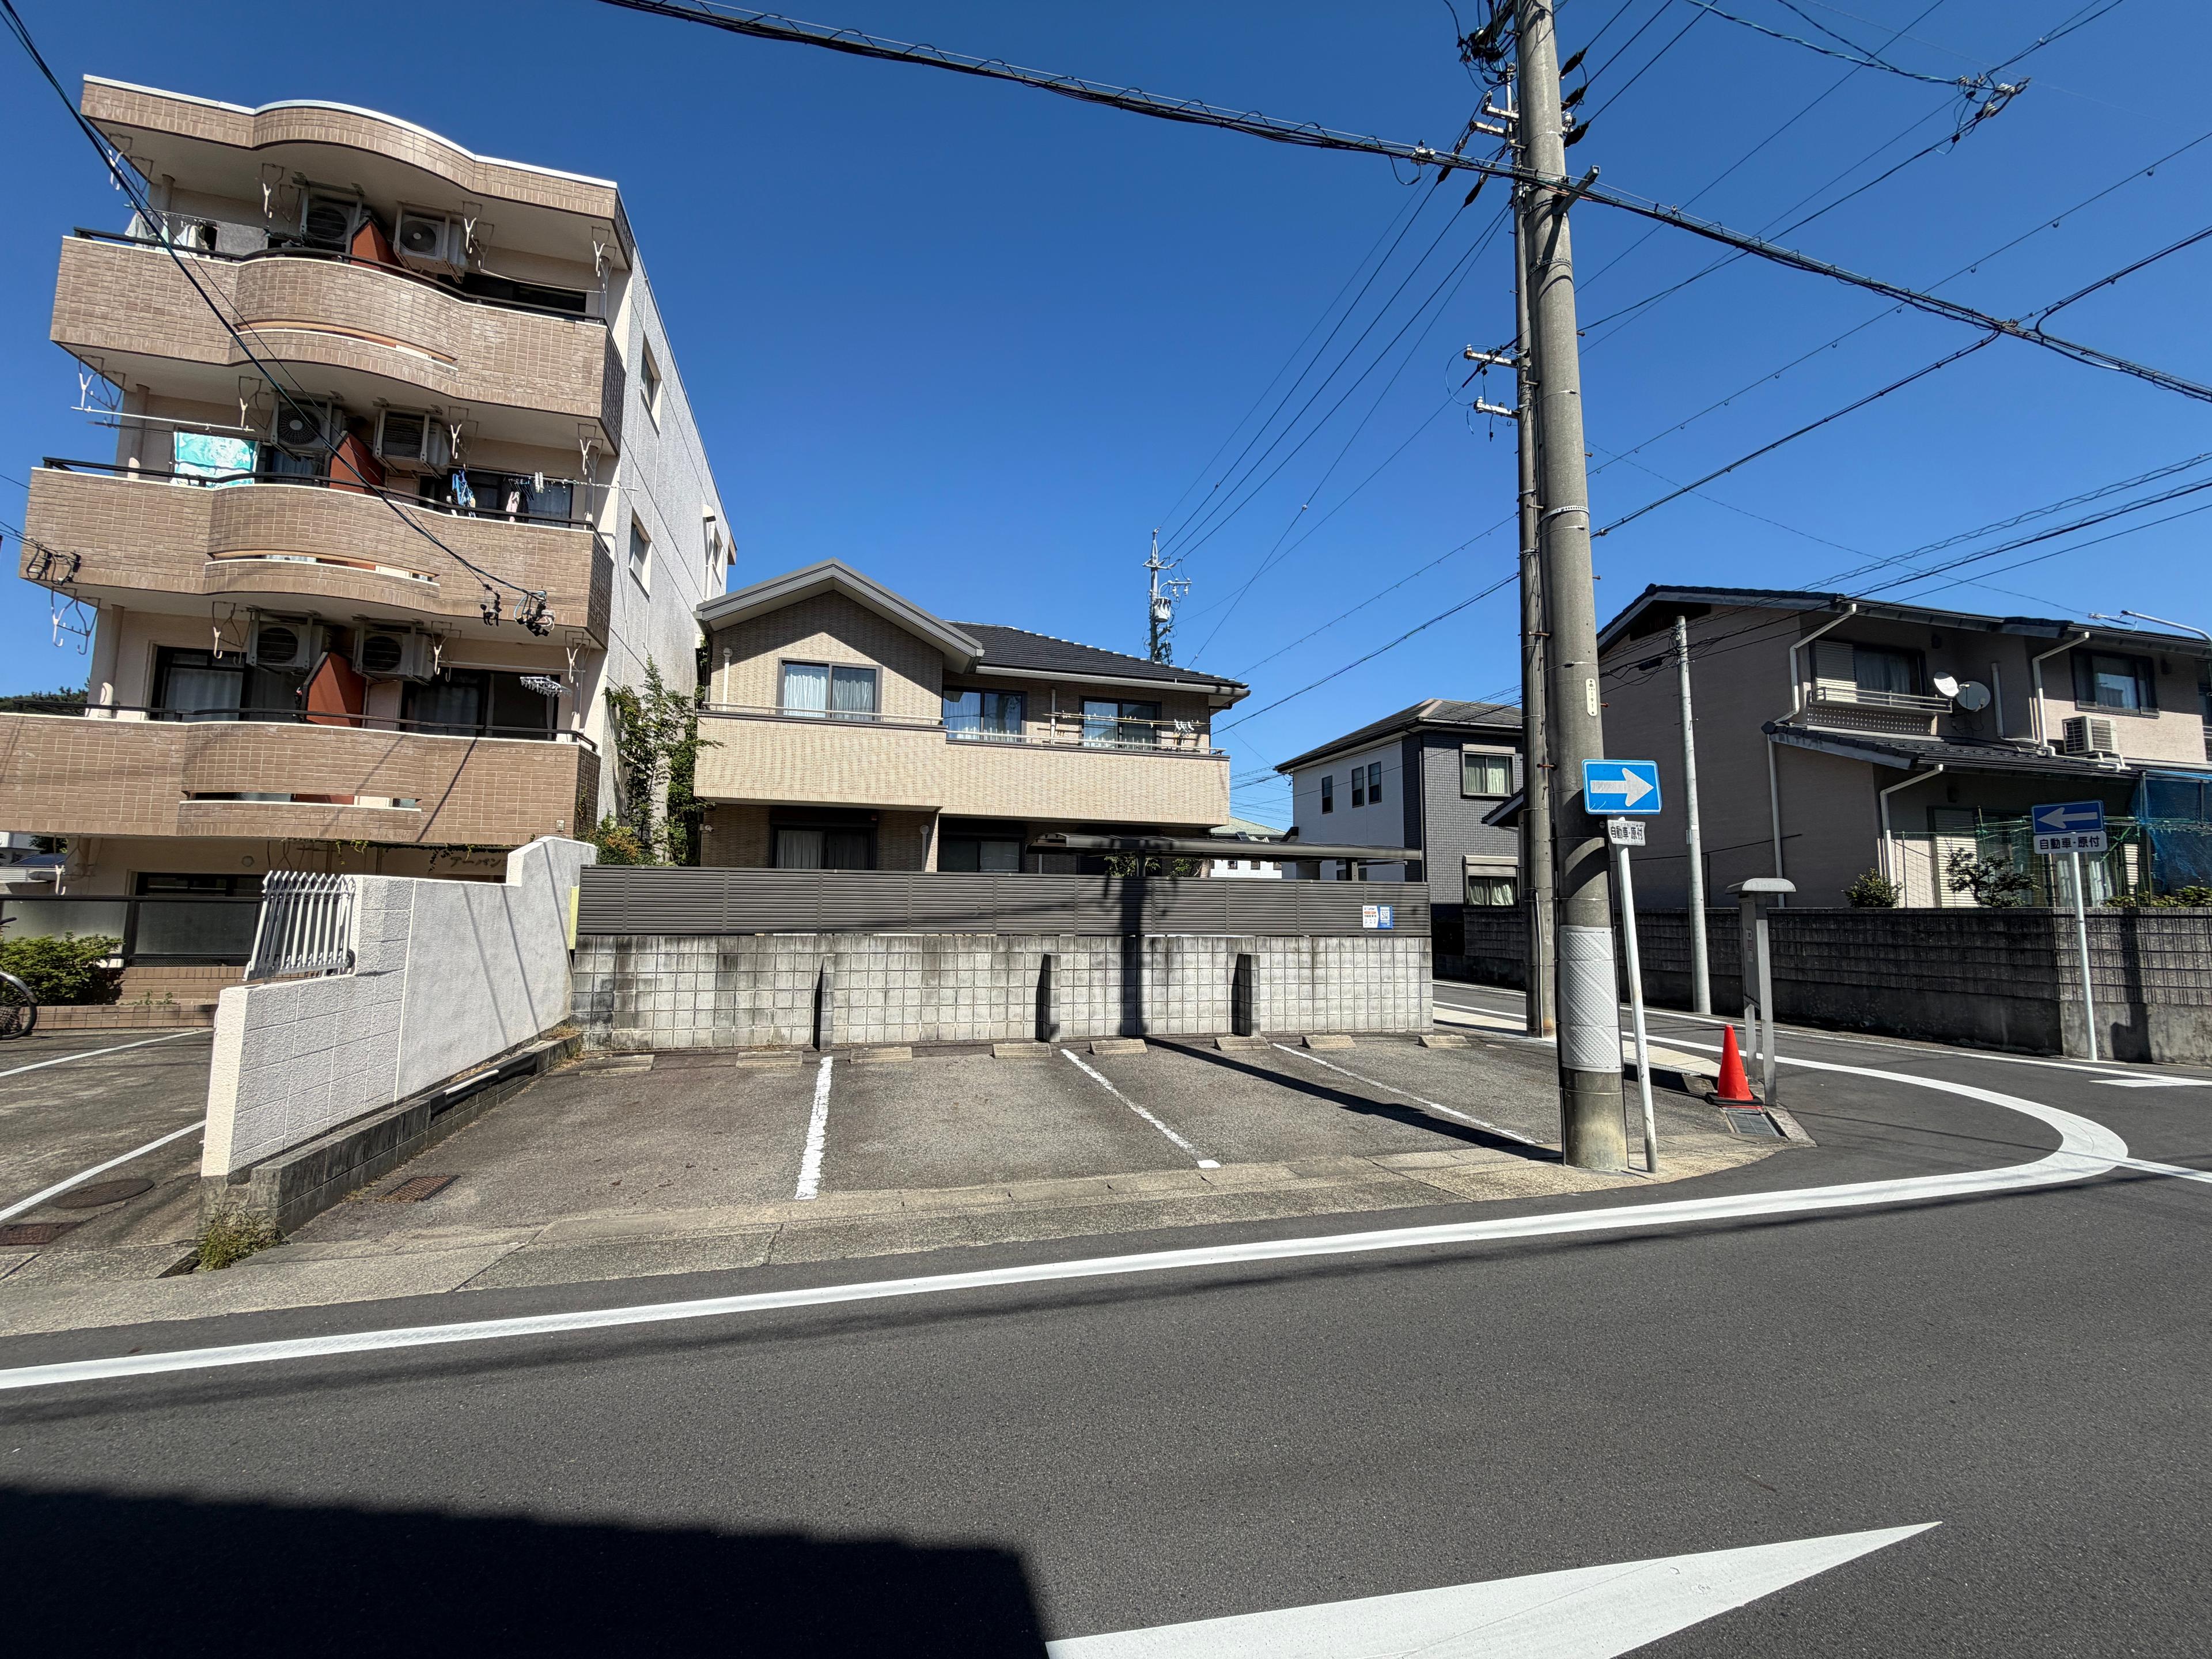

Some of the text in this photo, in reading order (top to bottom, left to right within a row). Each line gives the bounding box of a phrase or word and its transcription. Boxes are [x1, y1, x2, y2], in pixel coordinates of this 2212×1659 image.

[2040, 835, 2100, 850] 自動車・原付
